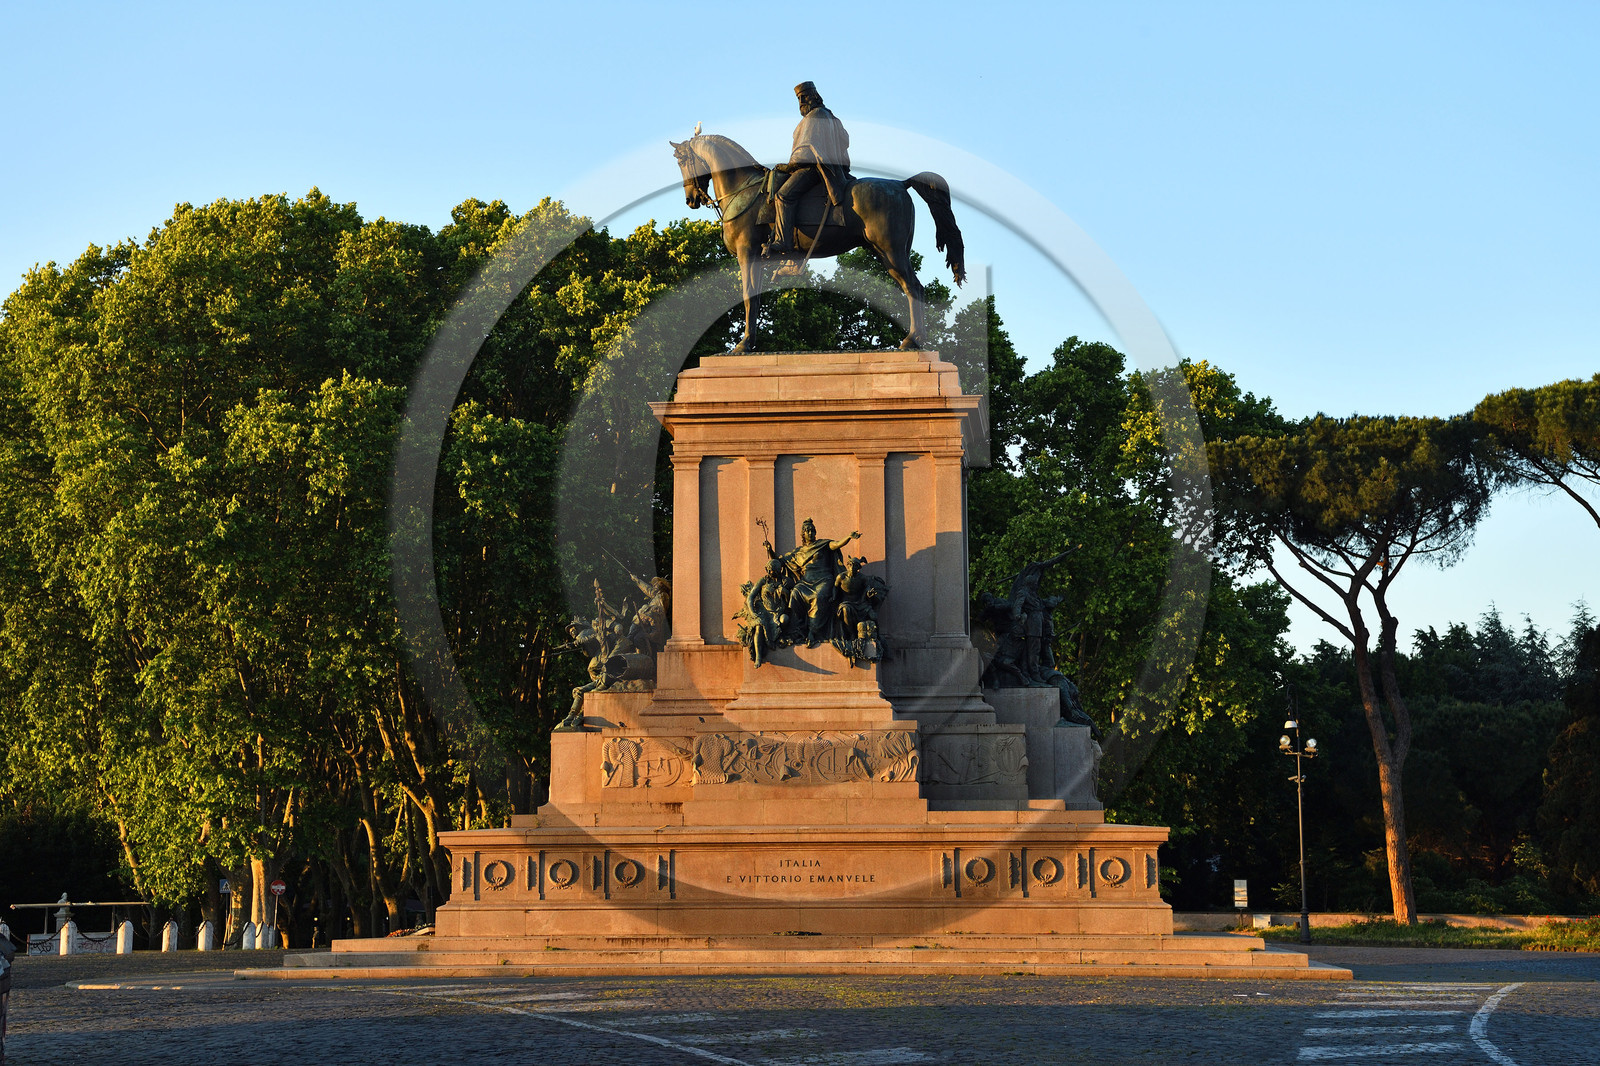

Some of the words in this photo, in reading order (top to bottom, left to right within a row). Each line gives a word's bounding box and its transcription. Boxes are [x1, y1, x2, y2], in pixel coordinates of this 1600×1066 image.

[779, 859, 821, 867] ITALIA
[726, 875, 732, 883] E
[739, 875, 802, 883] VITTORIO
[809, 874, 875, 883] EMANVELE
